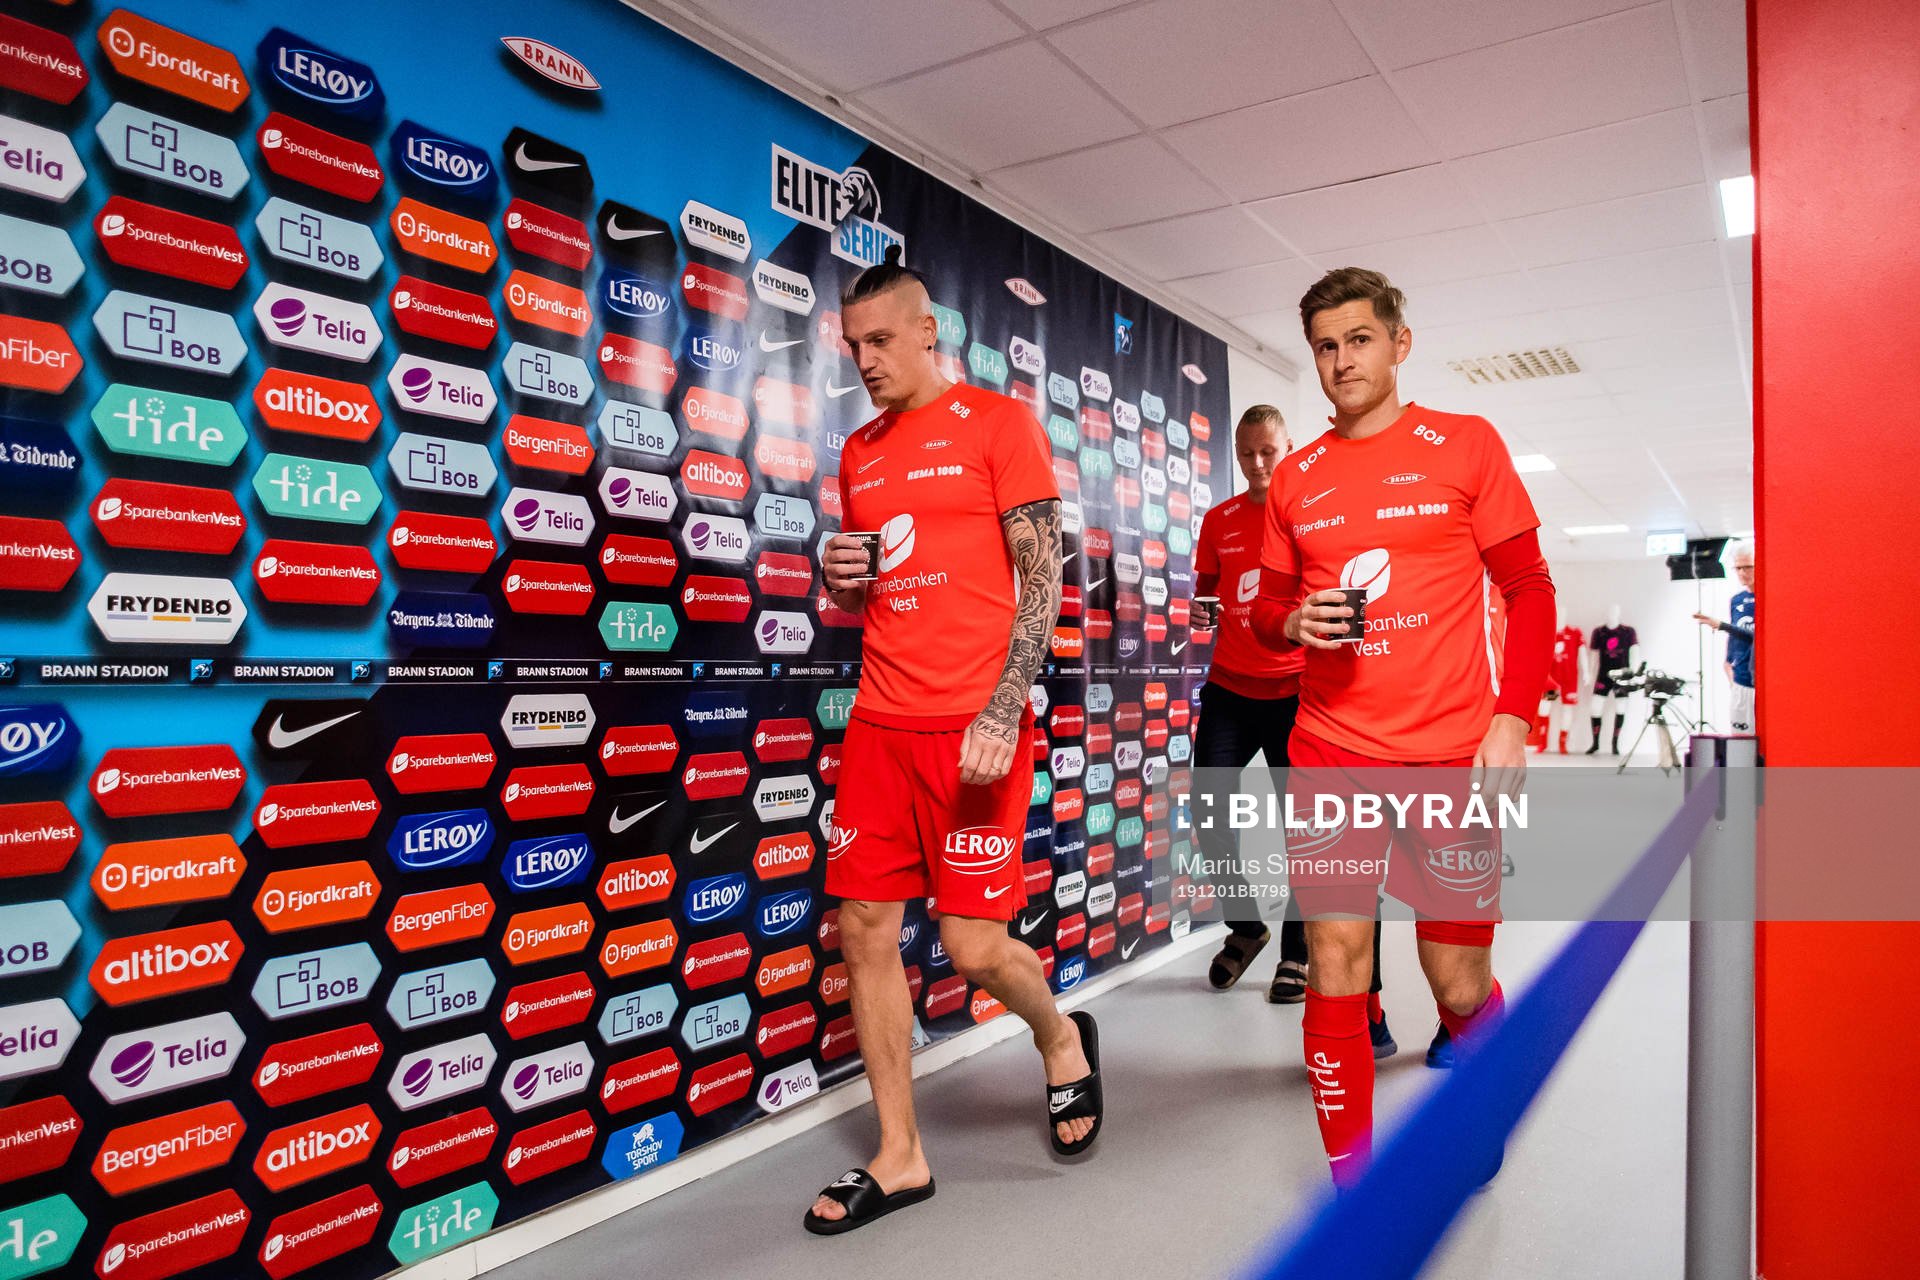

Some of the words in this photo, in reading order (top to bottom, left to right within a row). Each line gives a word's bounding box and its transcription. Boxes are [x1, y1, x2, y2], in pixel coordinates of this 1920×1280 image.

[138, 42, 241, 94] Fjordkraft
[278, 47, 366, 99] LERØY
[523, 42, 584, 84] BRANN
[283, 137, 380, 180] SparebankenVest
[408, 136, 483, 181] LERØY
[172, 159, 224, 188] BOB
[777, 155, 843, 226] ELITE
[127, 223, 244, 264] SparebankenVest
[418, 224, 491, 258] Fjordkraft
[522, 220, 591, 252] SparebankenVest
[317, 246, 360, 271] BOB
[609, 280, 666, 314] LERØY
[1014, 282, 1037, 302] BRANN
[412, 297, 494, 328] SparebankenVest
[528, 293, 587, 322] Fjordkraft
[312, 314, 366, 344] Telia
[171, 340, 221, 366] BOB
[692, 336, 740, 365] LERØY
[1024, 352, 1040, 368] Telia
[439, 380, 483, 408] Telia
[548, 379, 578, 399] BOB
[1094, 380, 1108, 394] Telia
[264, 387, 370, 424] altibox
[701, 404, 744, 427] Fjordkraft
[949, 401, 971, 419] BOB
[113, 398, 224, 451] tide
[1413, 424, 1446, 446] BOB
[509, 430, 588, 459] BergenFiber
[638, 434, 664, 450] BOB
[770, 448, 813, 469] Fjordkraft
[1298, 446, 1327, 473] BOB
[442, 465, 478, 489] BOB
[687, 461, 744, 488] altibox
[907, 468, 935, 480] REMA
[937, 465, 963, 476] 1000
[1390, 474, 1419, 484] BRANN
[269, 464, 361, 511] tide
[636, 488, 668, 508] Telia
[123, 503, 242, 527] SparebankenVest
[545, 509, 584, 531] Telia
[1377, 506, 1415, 519] REMA
[1418, 503, 1449, 516] 1000
[784, 520, 804, 534] BOB
[1300, 515, 1345, 536] Fjordkraft
[410, 531, 494, 551] SparebankenVest
[714, 530, 743, 549] Telia
[278, 561, 377, 579] SparebankenVest
[616, 551, 676, 567] SparebankenVest
[521, 578, 592, 593] SparebankenVest
[695, 591, 750, 603] SparebankenVest
[107, 594, 231, 616] FRYDENBØ
[890, 597, 919, 612] Vest
[456, 614, 494, 629] Tidende
[610, 608, 666, 642] tide
[781, 627, 806, 642] Telia
[1352, 639, 1391, 656] Vest
[42, 665, 98, 677] BRANN
[102, 665, 169, 678] STADION
[234, 666, 278, 677] BRANN
[281, 666, 334, 677] STADION
[388, 667, 426, 676] BRANN
[429, 667, 473, 677] STADION
[517, 667, 550, 676] BRANN
[552, 667, 588, 677] STADION
[625, 668, 650, 676] BRANN
[652, 668, 682, 676] STADION
[615, 741, 676, 754] SparebankenVest
[766, 732, 812, 743] SparebankenVest
[410, 752, 493, 768] SparebankenVest
[1066, 758, 1080, 769] Telia
[1127, 751, 1139, 761] Telia
[122, 767, 241, 788] SparebankenVest
[696, 766, 748, 780] SparebankenVest
[520, 781, 592, 797] SparebankenVest
[279, 799, 376, 820] SparebankenVest
[404, 823, 482, 854] LERØY
[946, 833, 1014, 856] LERØY
[516, 846, 583, 877] LERØY
[758, 845, 809, 867] altibox
[132, 856, 236, 887] Fjordkraft
[604, 868, 669, 896] altibox
[288, 881, 372, 911] Fjordkraft
[692, 884, 742, 912] LERØY
[394, 901, 488, 933] BergenFiber
[764, 900, 808, 926] LERØY
[527, 920, 588, 946] Fjordkraft
[621, 934, 673, 959] Fjordkraft
[695, 947, 749, 969] SparebankenVest
[104, 940, 231, 986] altibox
[771, 960, 810, 982] Fjordkraft
[317, 977, 358, 1001] BOB
[520, 988, 592, 1014] SparebankenVest
[442, 991, 477, 1012] BOB
[637, 1012, 663, 1029] BOB
[716, 1020, 739, 1037] BOB
[768, 1014, 815, 1038] SparebankenVest
[163, 1037, 227, 1069] Telia
[281, 1042, 379, 1077] SparebankenVest
[439, 1056, 483, 1081] Telia
[544, 1062, 583, 1086] Telia
[616, 1062, 678, 1090] SparebankenVest
[701, 1067, 752, 1092] SparebankenVest
[785, 1075, 811, 1095] Telia
[1051, 1089, 1075, 1104] NIKE
[1307, 1051, 1345, 1121] tide
[103, 1121, 236, 1173] BergenFiber
[266, 1121, 370, 1172] altibox
[411, 1124, 494, 1160] SparebankenVest
[522, 1126, 594, 1159] SparebankenVest
[626, 1140, 663, 1162] TORSHOV
[632, 1152, 658, 1171] SPORT
[128, 1209, 245, 1258] SparebankenVest
[285, 1202, 378, 1248] SparebankenVest
[403, 1199, 482, 1249] tide
